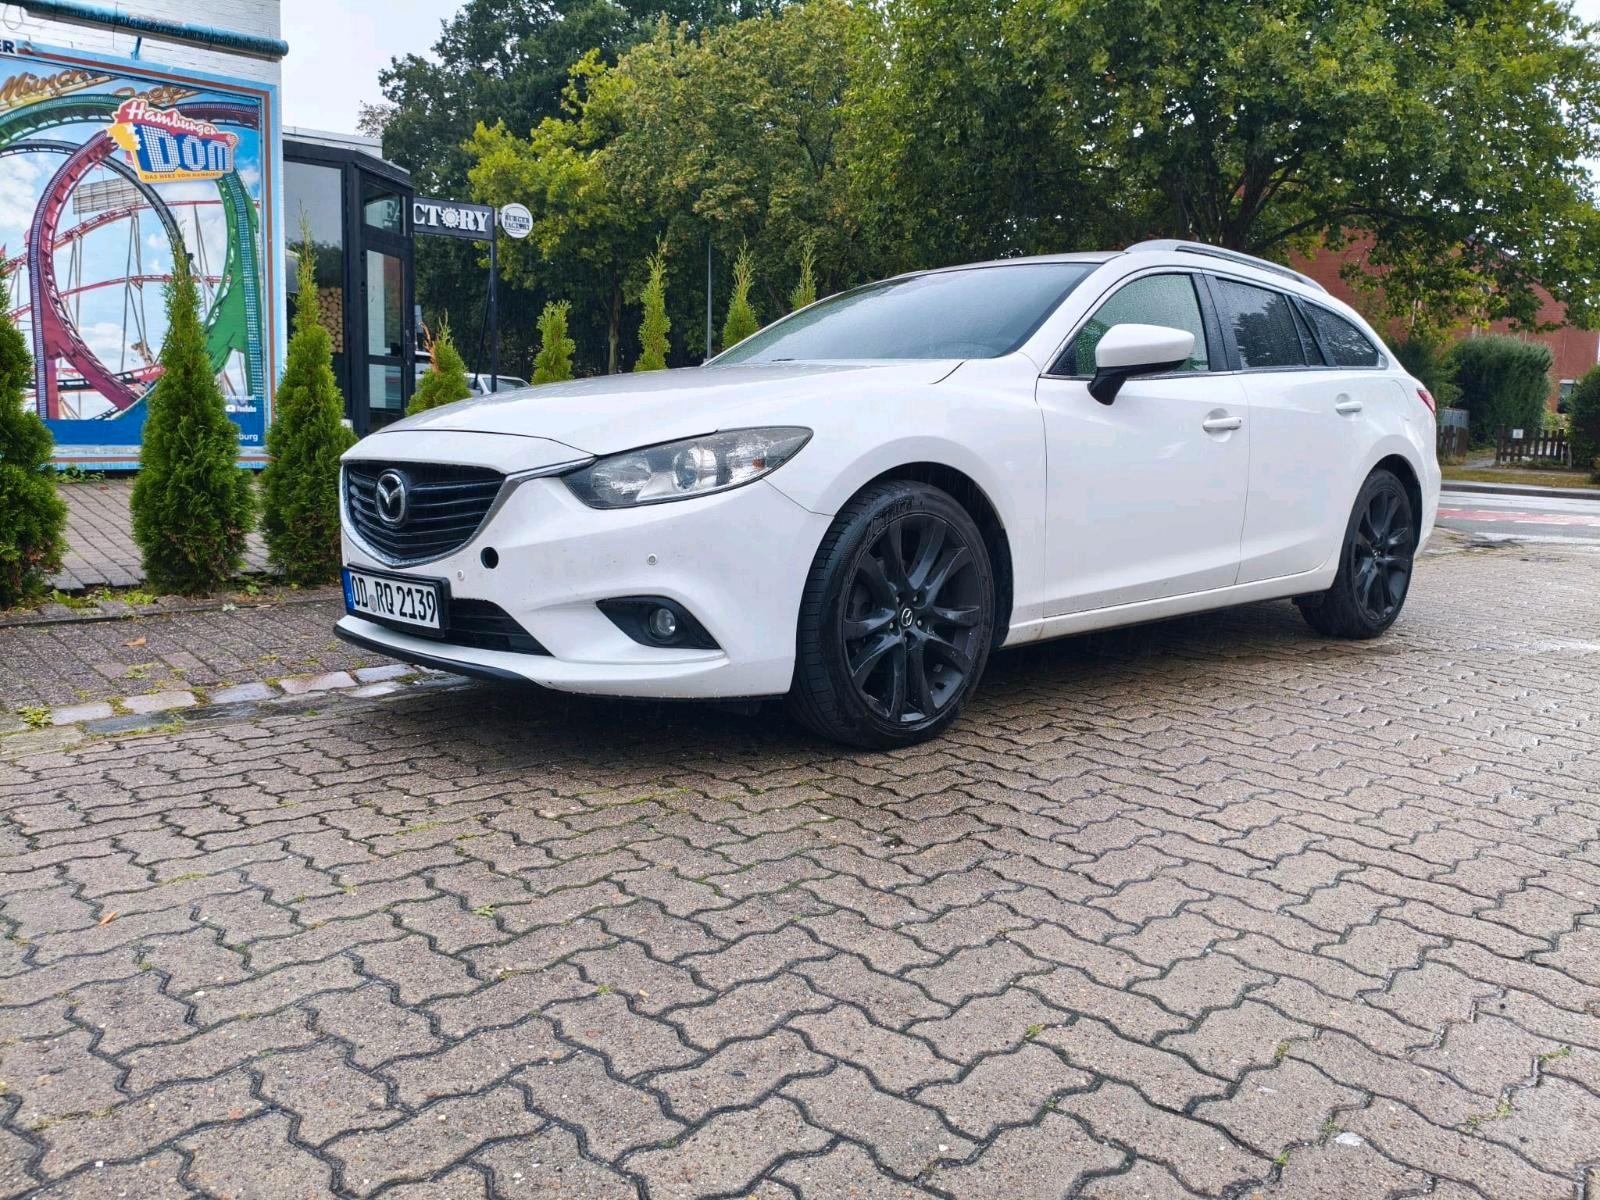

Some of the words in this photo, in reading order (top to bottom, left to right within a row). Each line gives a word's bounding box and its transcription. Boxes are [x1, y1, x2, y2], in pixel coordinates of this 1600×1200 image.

[126, 101, 219, 136] Hamburger
[237, 432, 259, 442] burg
[351, 576, 368, 607] OD
[374, 580, 395, 615] RQ
[396, 586, 436, 622] 2139
